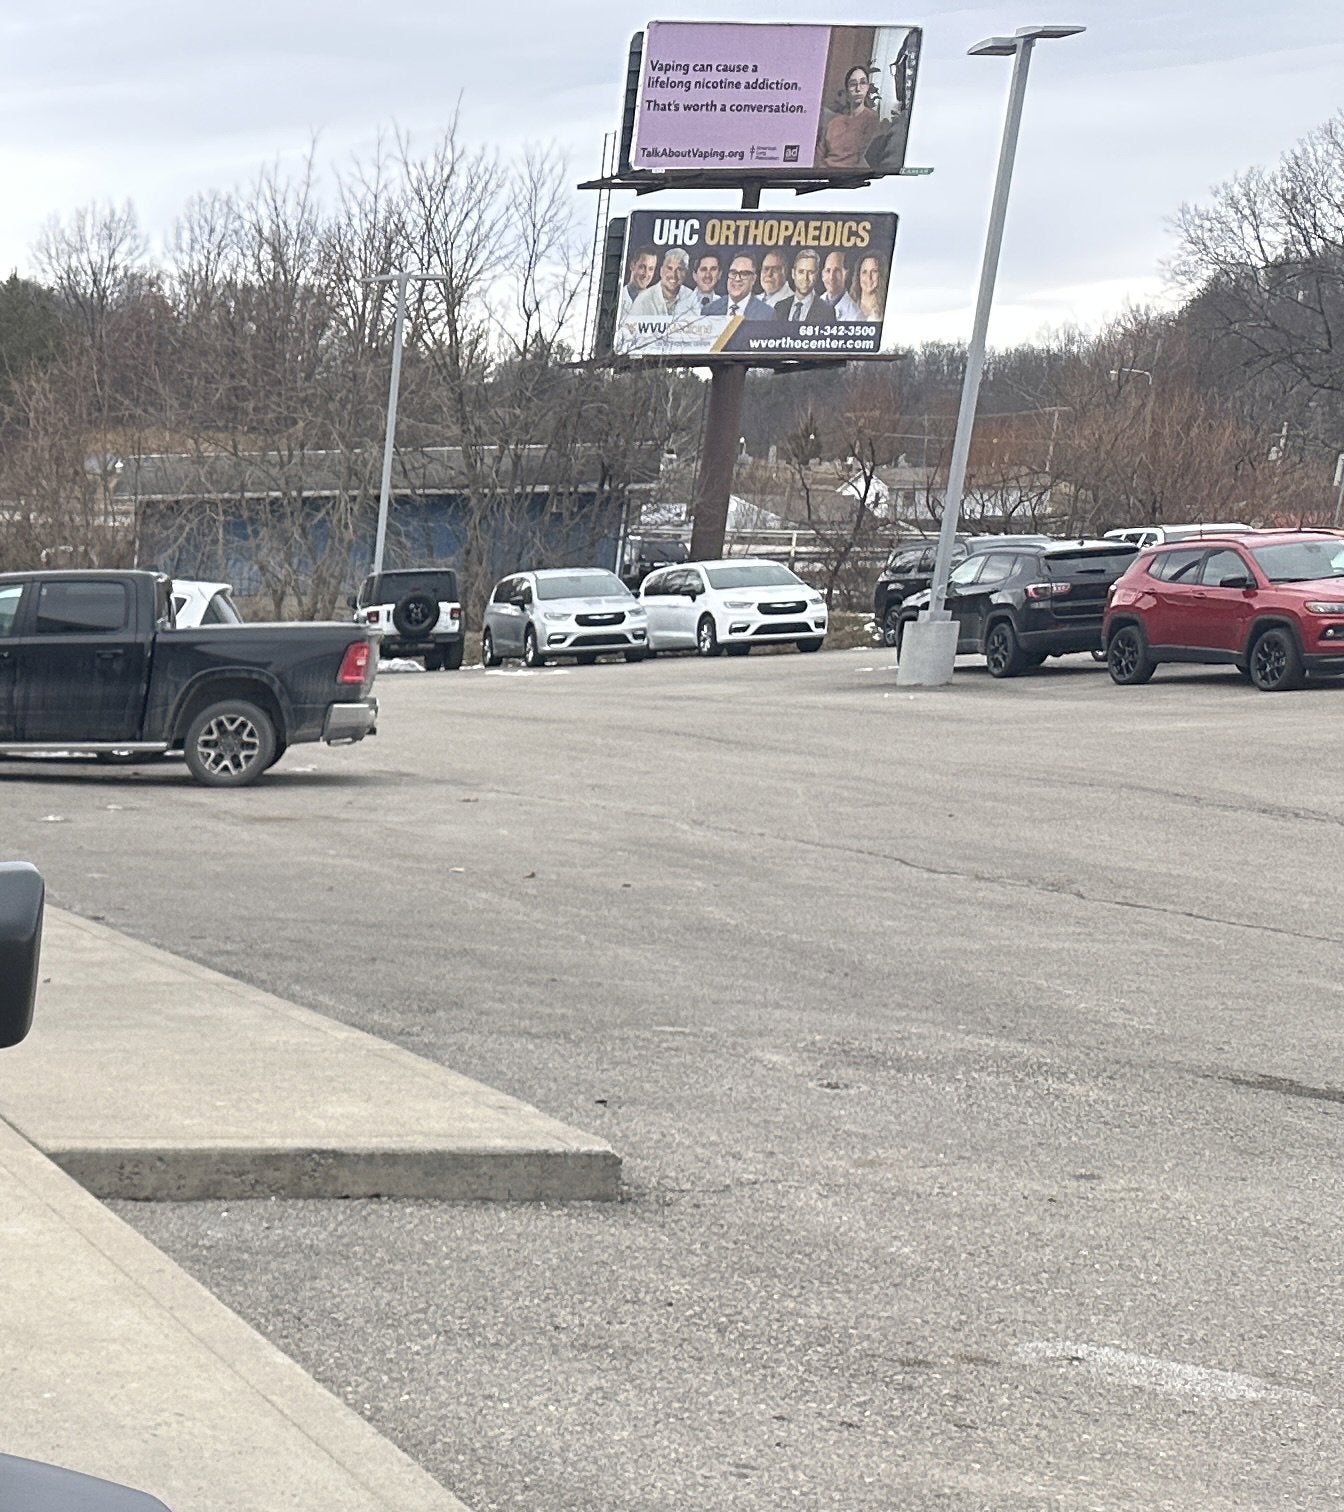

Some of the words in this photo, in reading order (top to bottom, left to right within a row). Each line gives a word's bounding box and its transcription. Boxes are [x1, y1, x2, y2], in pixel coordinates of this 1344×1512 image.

[650, 60, 690, 76] Vaping
[692, 63, 713, 73] can
[716, 63, 749, 73] cause
[751, 64, 758, 73] a
[647, 76, 691, 92] lifelong
[694, 77, 741, 90] nicotine
[744, 78, 802, 91] addiction.
[646, 100, 680, 112] That's
[683, 100, 717, 112] worth
[720, 103, 727, 112] a
[729, 102, 807, 114] conversation.
[640, 147, 745, 161] TalkAboutVaping.org
[653, 218, 700, 246] UHC
[704, 218, 872, 247] ORTHOPAEDICS
[638, 322, 667, 334] WVU
[798, 325, 876, 336] 681-342-3500
[749, 336, 874, 349] wvorthocenter.com
